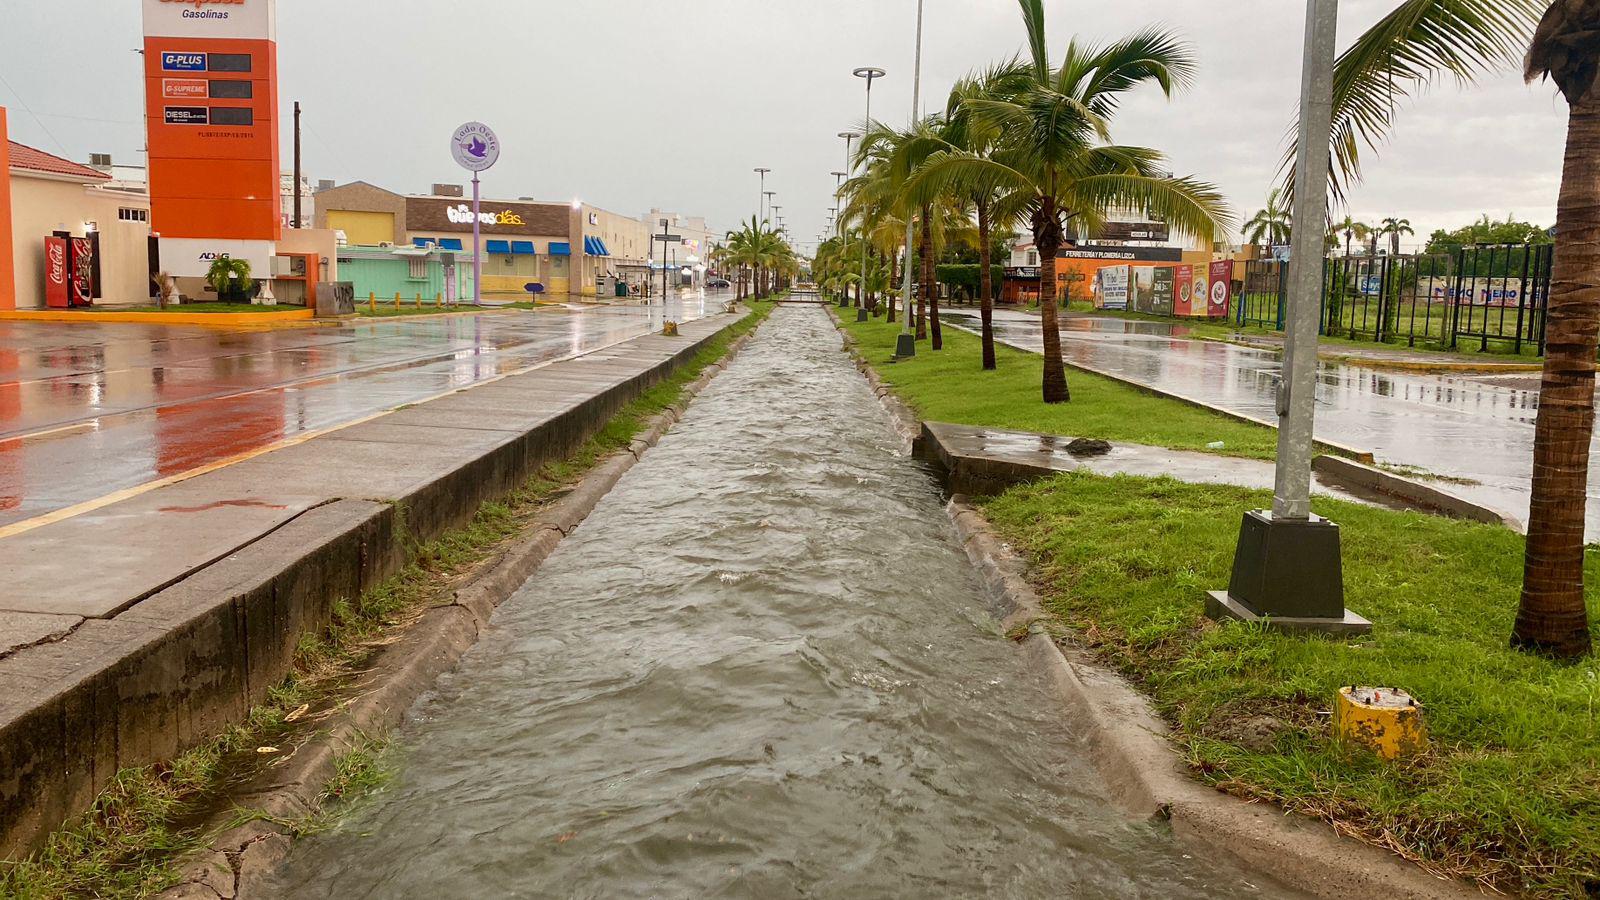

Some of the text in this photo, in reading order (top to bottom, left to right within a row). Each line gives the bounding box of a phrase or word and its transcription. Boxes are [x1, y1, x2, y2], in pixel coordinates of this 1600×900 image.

[182, 9, 229, 19] Gasolinas
[165, 55, 203, 65] G-PLUS
[166, 85, 205, 93] G-SUPREME
[454, 125, 496, 151] Lado Oeste
